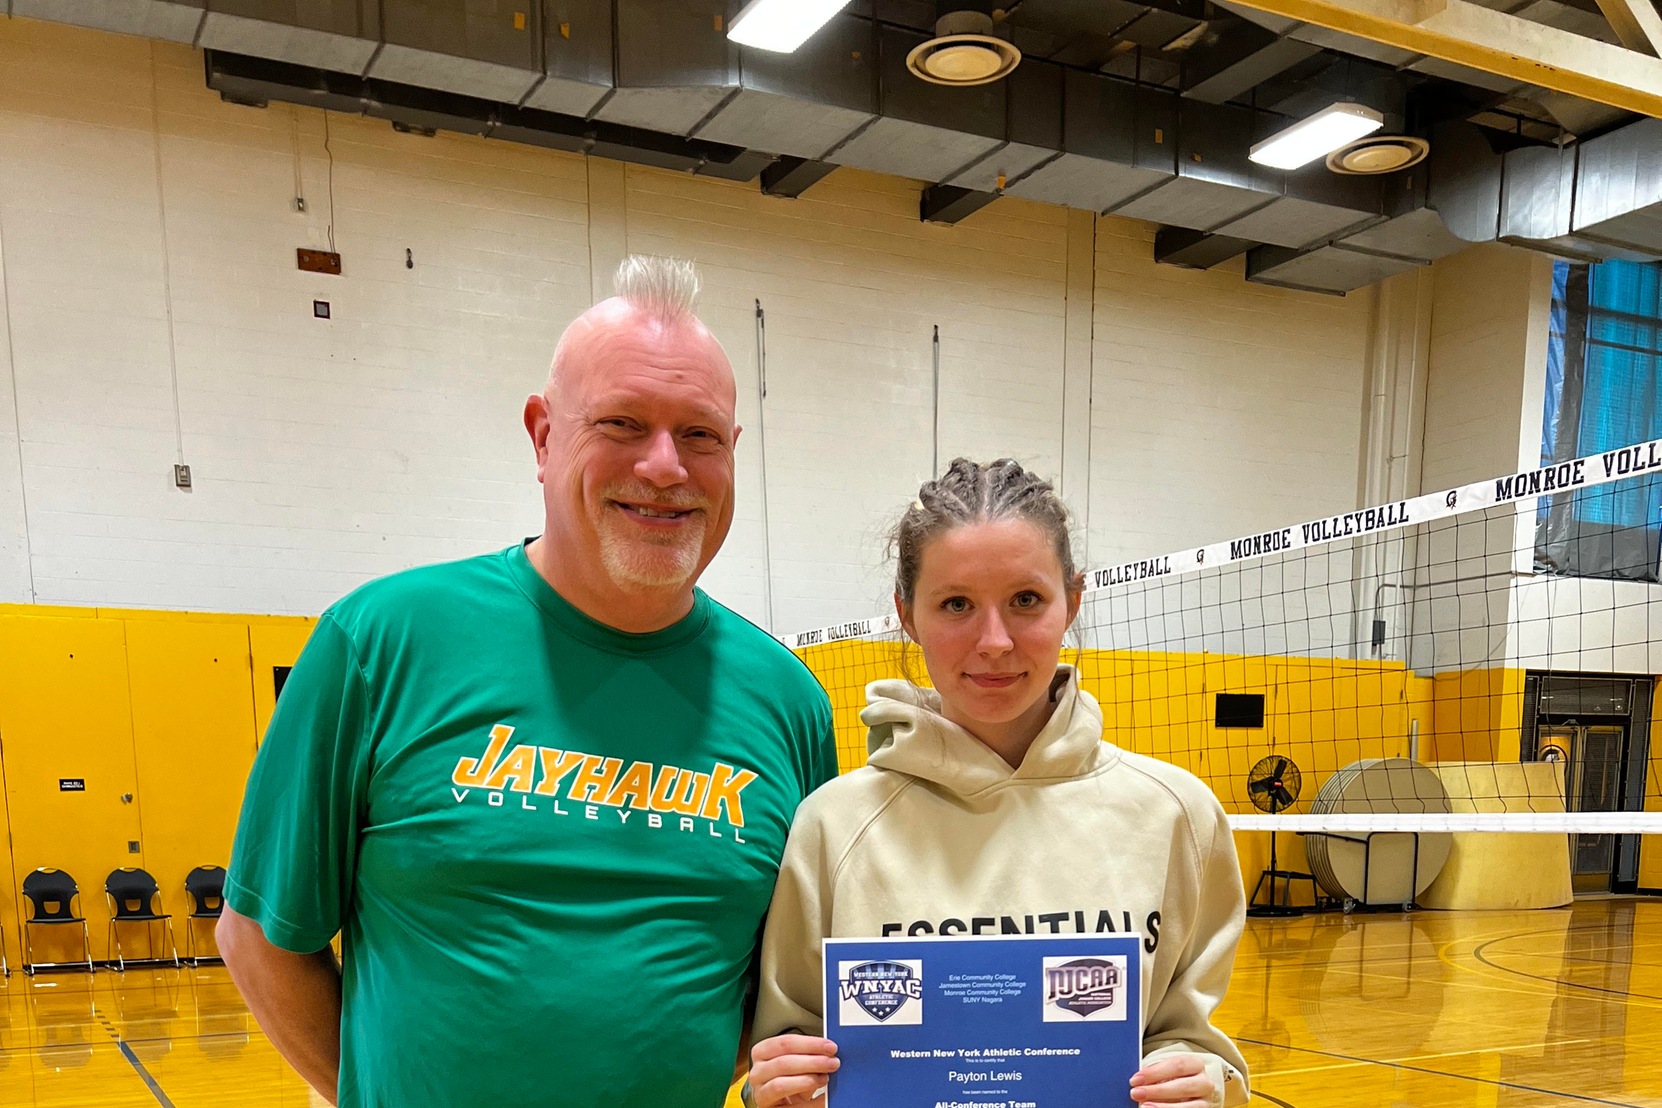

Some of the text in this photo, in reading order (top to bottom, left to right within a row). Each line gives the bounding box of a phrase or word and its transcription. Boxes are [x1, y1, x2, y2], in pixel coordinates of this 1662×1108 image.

[1495, 460, 1585, 502] MONROE
[1230, 502, 1410, 560] MONROE VOLLEYBALL
[1094, 556, 1171, 588] VOLLEYBALL
[827, 620, 872, 641] VOLLEYBALL
[451, 723, 759, 828] JAYHAWK
[451, 787, 746, 844] VOLLEYBALL
[961, 974, 994, 982] Community
[994, 973, 1016, 981] College
[840, 979, 922, 1000] WNYAC
[999, 988, 1021, 996] College
[890, 1050, 931, 1058] Western
[957, 1049, 981, 1057] York
[982, 1048, 1022, 1057] Athletic
[1023, 1047, 1081, 1056] Conference
[948, 1070, 1023, 1084] Payton Lewis
[1008, 1100, 1036, 1108] Team
